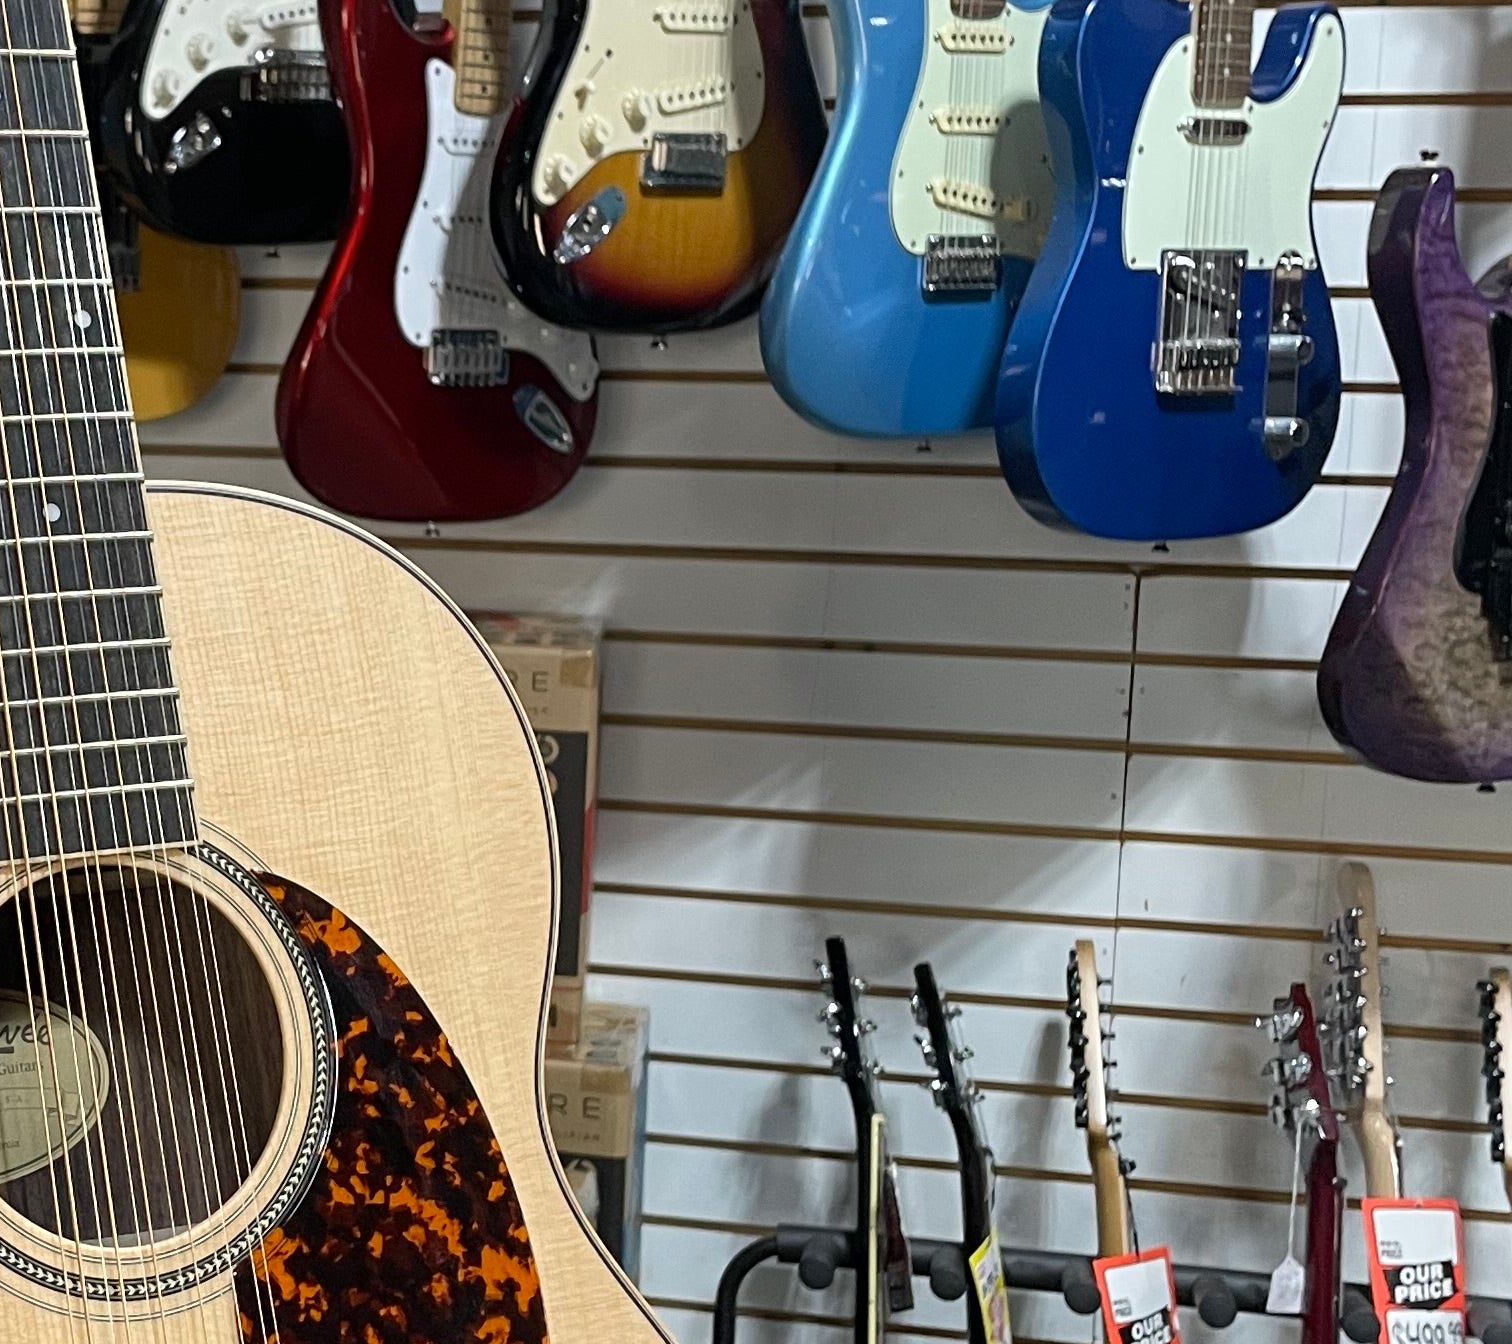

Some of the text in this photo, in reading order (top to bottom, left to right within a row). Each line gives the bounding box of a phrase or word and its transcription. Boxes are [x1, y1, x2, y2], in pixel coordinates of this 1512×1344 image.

[1399, 1263, 1444, 1284] OUR
[1394, 1277, 1454, 1305] PRICE
[1131, 1311, 1164, 1340] OUR
